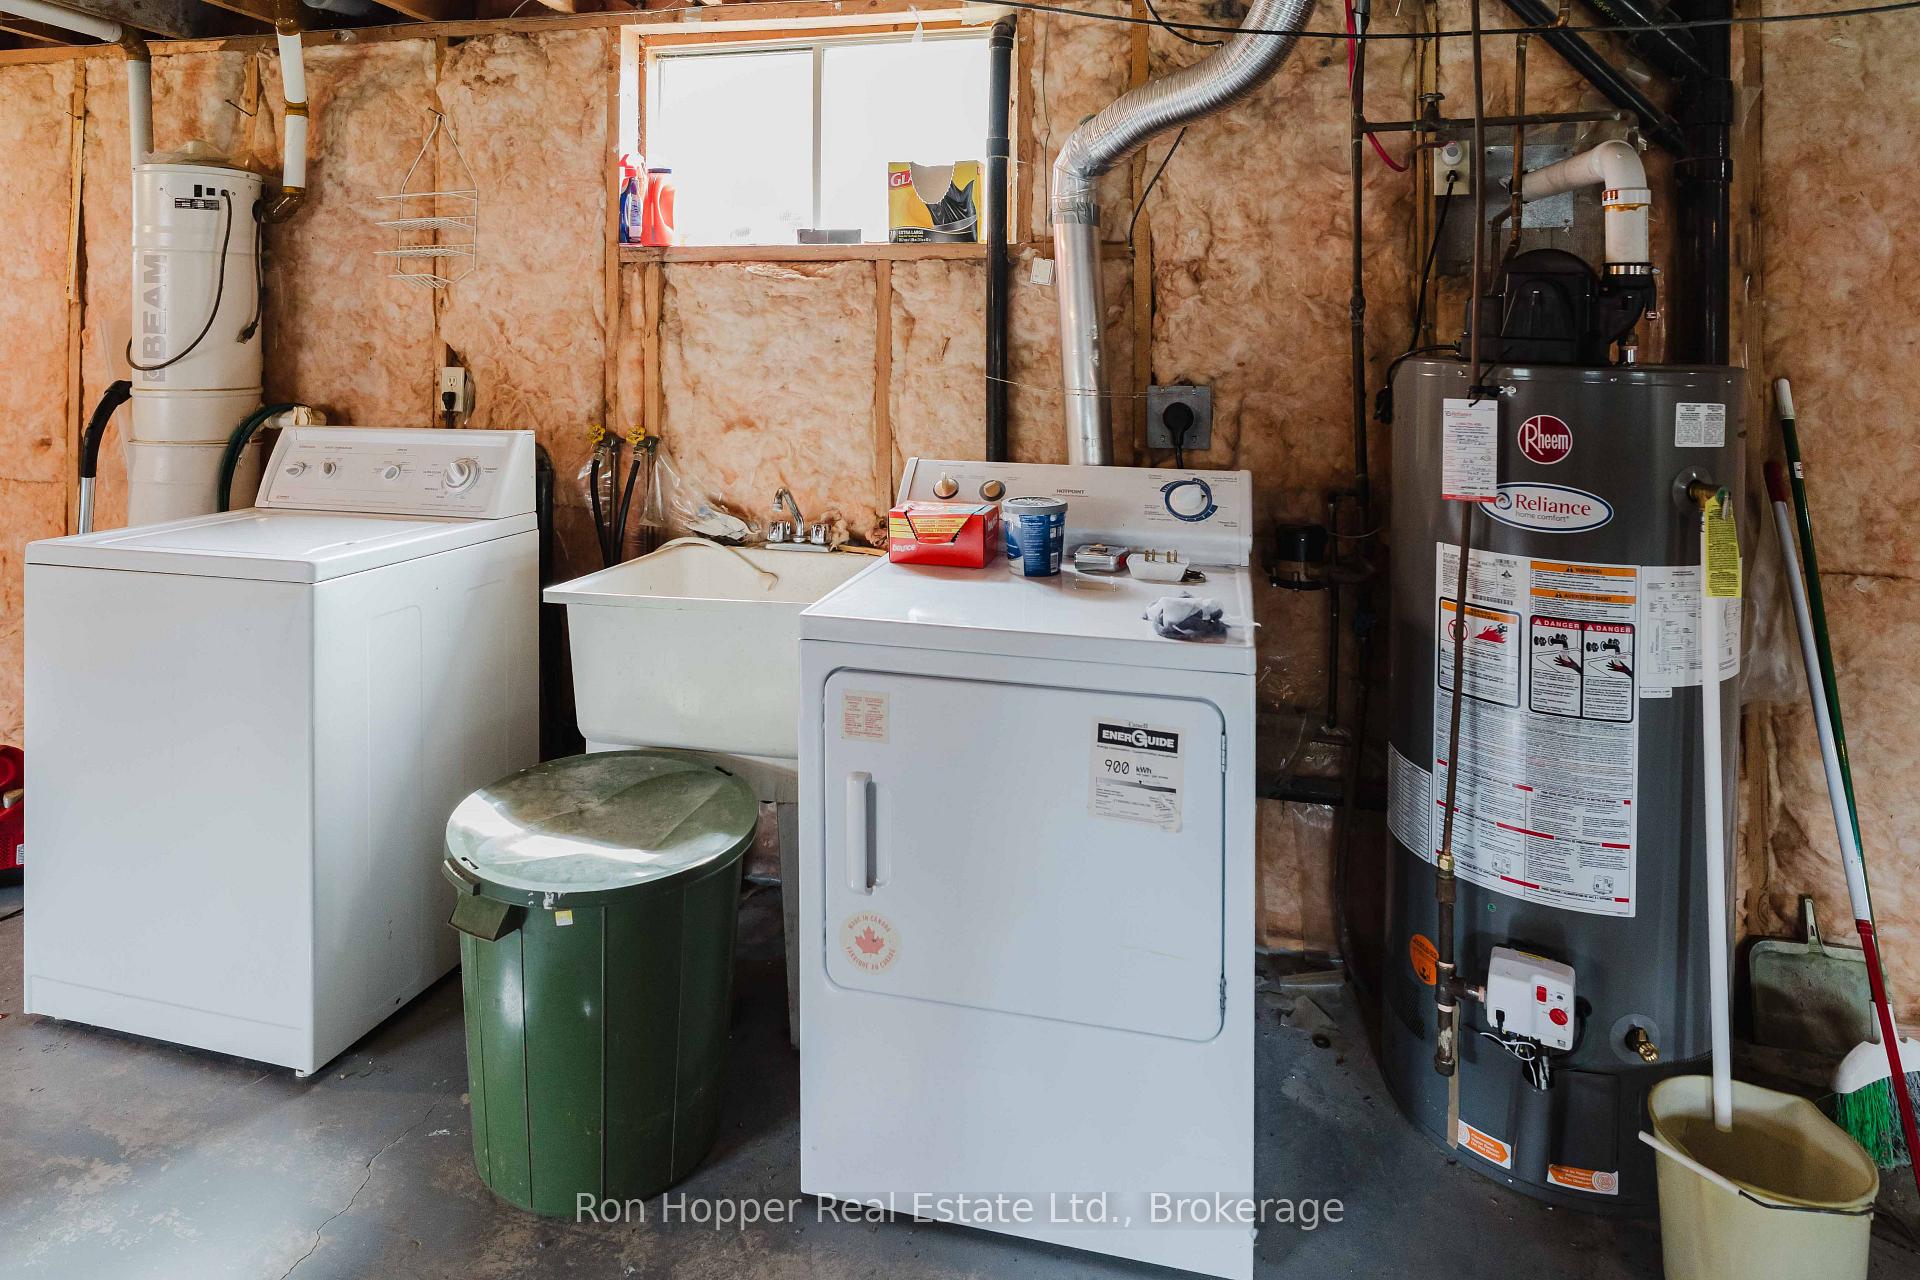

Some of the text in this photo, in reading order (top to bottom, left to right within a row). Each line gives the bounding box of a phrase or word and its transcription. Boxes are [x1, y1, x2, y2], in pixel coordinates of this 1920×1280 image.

[143, 255, 168, 359] BEAM
[1525, 415, 1569, 455] Rheem
[1515, 494, 1591, 516] Reliance
[1515, 511, 1536, 519] home
[1544, 620, 1580, 629] DANGER
[1596, 625, 1631, 633] DANGER
[1102, 729, 1175, 748] ENERGUIDE
[1104, 759, 1152, 775] 900 kWh
